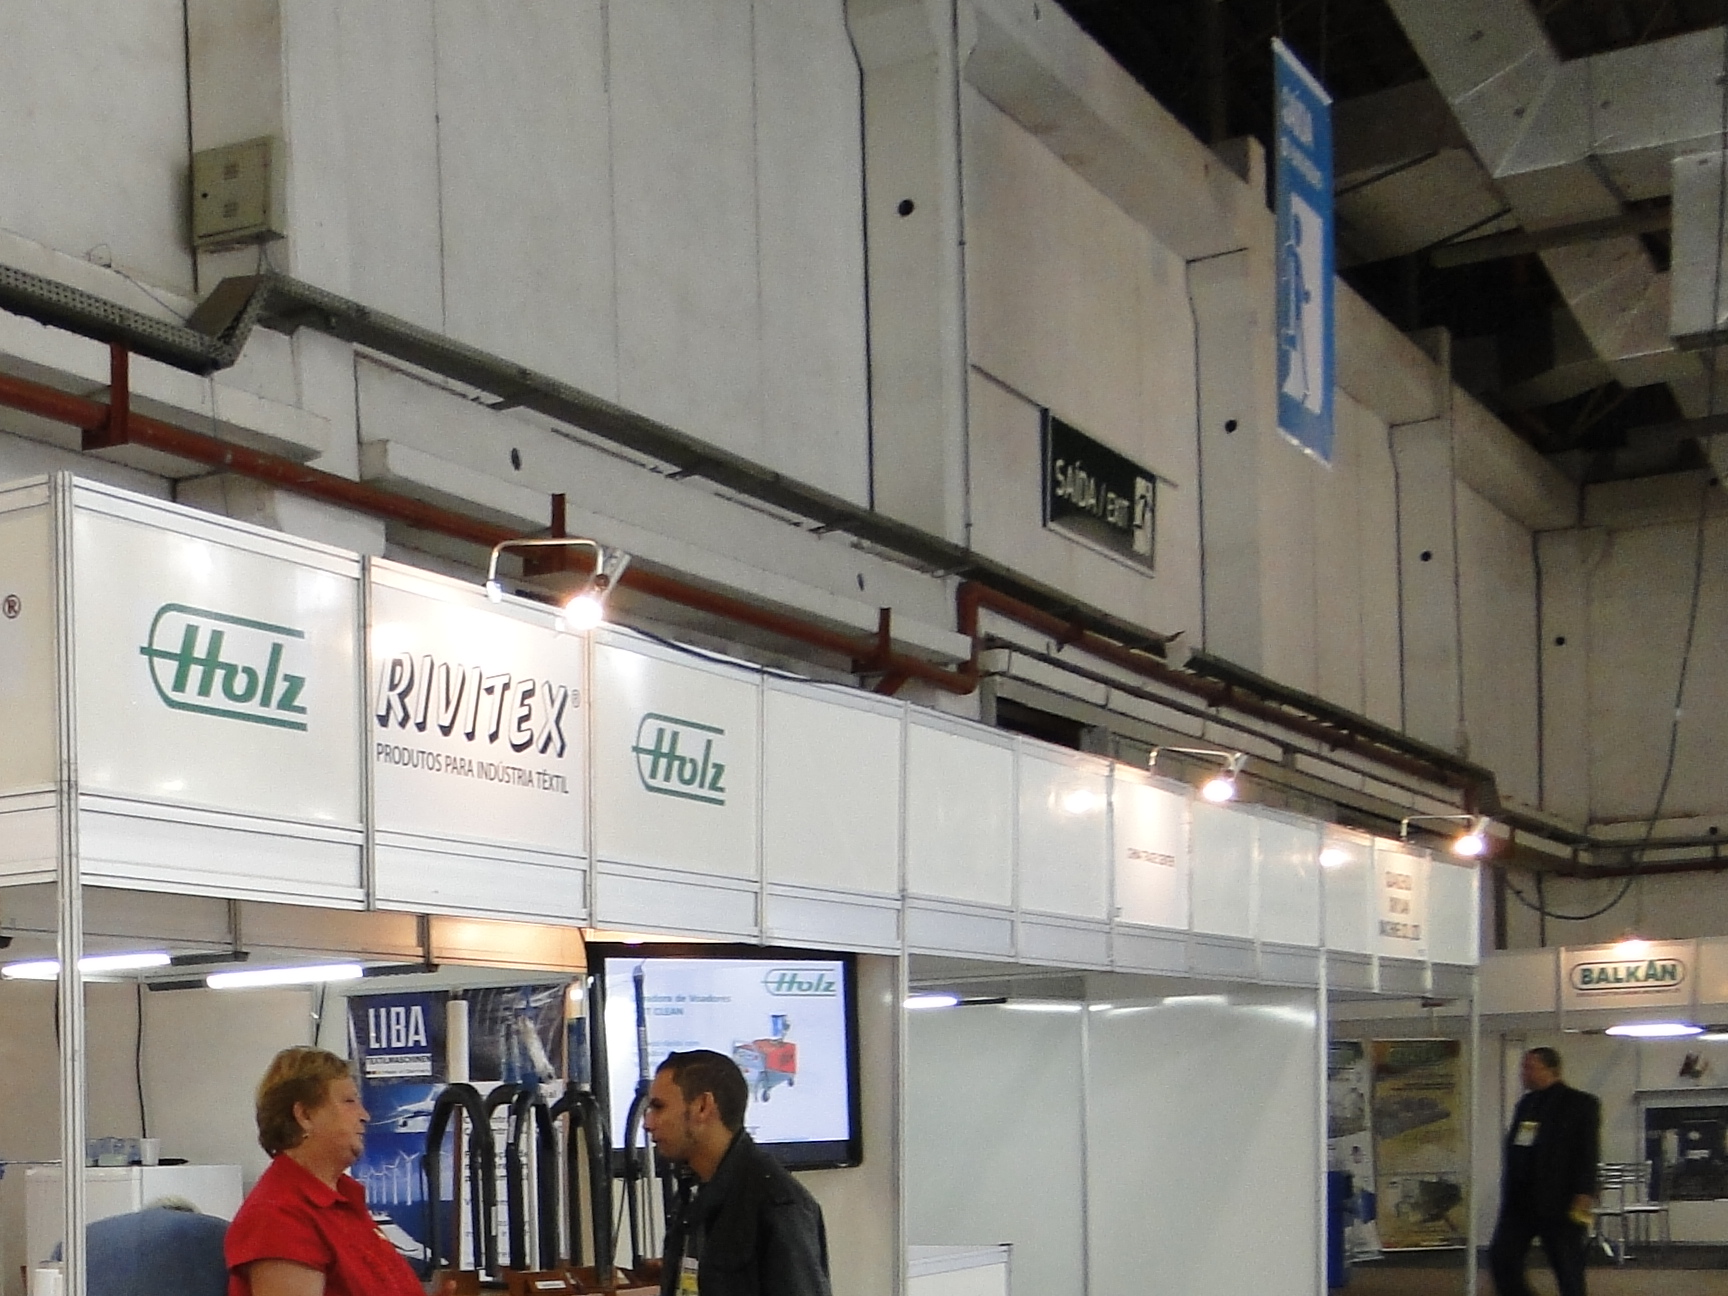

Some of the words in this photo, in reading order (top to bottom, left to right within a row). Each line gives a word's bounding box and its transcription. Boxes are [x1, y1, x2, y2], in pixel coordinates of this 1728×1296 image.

[1055, 459, 1097, 515] SAÍDA
[140, 623, 308, 714] Holz
[376, 743, 442, 772] PRODUTOS
[445, 756, 474, 778] PARA
[477, 762, 534, 787] INDÚSTRIA
[631, 728, 726, 793] Holz
[762, 973, 836, 993] Holz
[368, 1005, 427, 1049] LIBA
